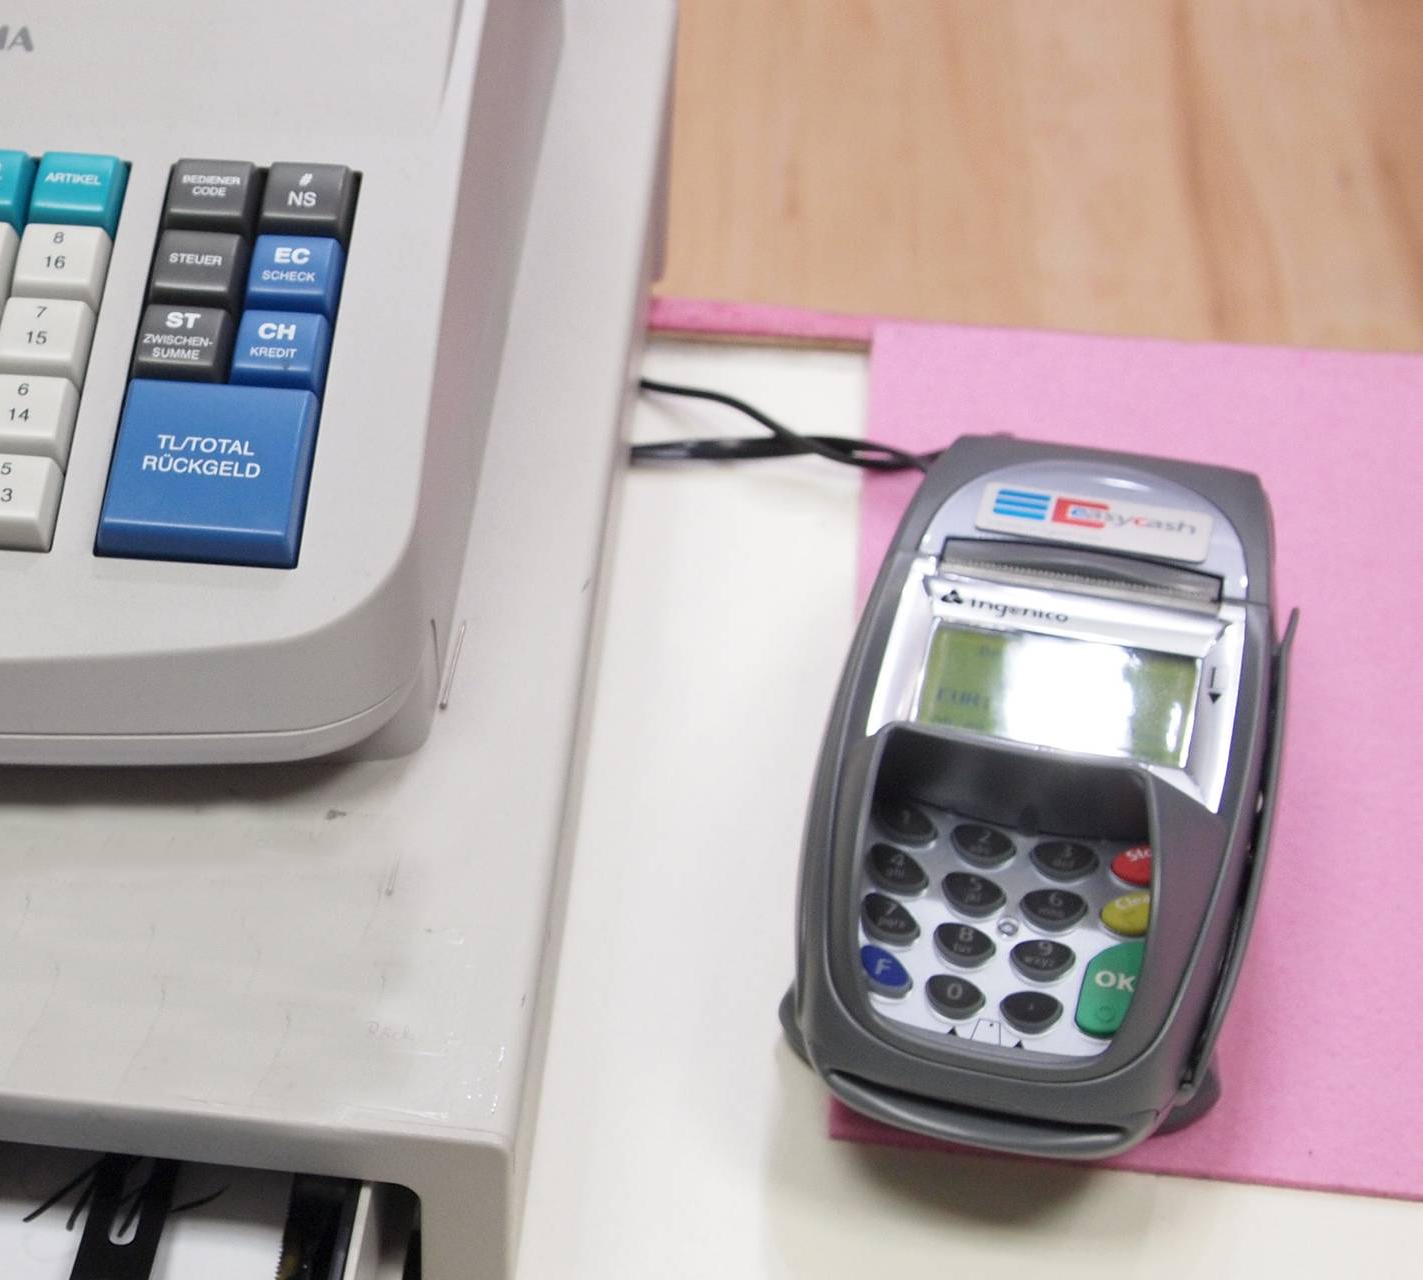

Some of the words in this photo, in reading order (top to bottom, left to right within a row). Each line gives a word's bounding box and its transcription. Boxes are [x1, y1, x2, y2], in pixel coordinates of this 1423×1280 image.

[45, 172, 102, 186] ARTIKEL
[182, 174, 242, 187] BEDIENER
[299, 173, 313, 187] #
[192, 186, 227, 198] CODE
[287, 191, 317, 208] NS
[53, 232, 65, 244] 8
[45, 255, 66, 270] 16
[169, 253, 223, 267] STEUER
[273, 247, 311, 265] EC
[261, 270, 316, 283] SCHECK
[36, 305, 48, 319] 7
[165, 311, 202, 329] ST
[27, 330, 48, 345] 15
[258, 322, 297, 341] CH
[143, 333, 214, 348] ZWISCHEN-
[152, 346, 200, 361] SUMME
[249, 345, 297, 359] KREDIT
[18, 383, 29, 396] 6
[9, 408, 30, 422] 14
[158, 434, 256, 456] TL/TOTAL
[0, 462, 12, 475] 5
[142, 453, 262, 478] RÜCKGELD
[1070, 506, 1198, 536] easycash
[979, 830, 992, 847] 2
[1061, 844, 1073, 858] 3
[1124, 847, 1153, 863] Sto
[889, 853, 905, 868] 4
[969, 876, 983, 893] 5
[1048, 892, 1063, 907] 6
[886, 903, 899, 916] 7
[957, 926, 974, 943] 8
[1039, 939, 1054, 956] 9
[875, 959, 892, 976] F
[1095, 971, 1135, 992] OK
[947, 983, 963, 999] 0
